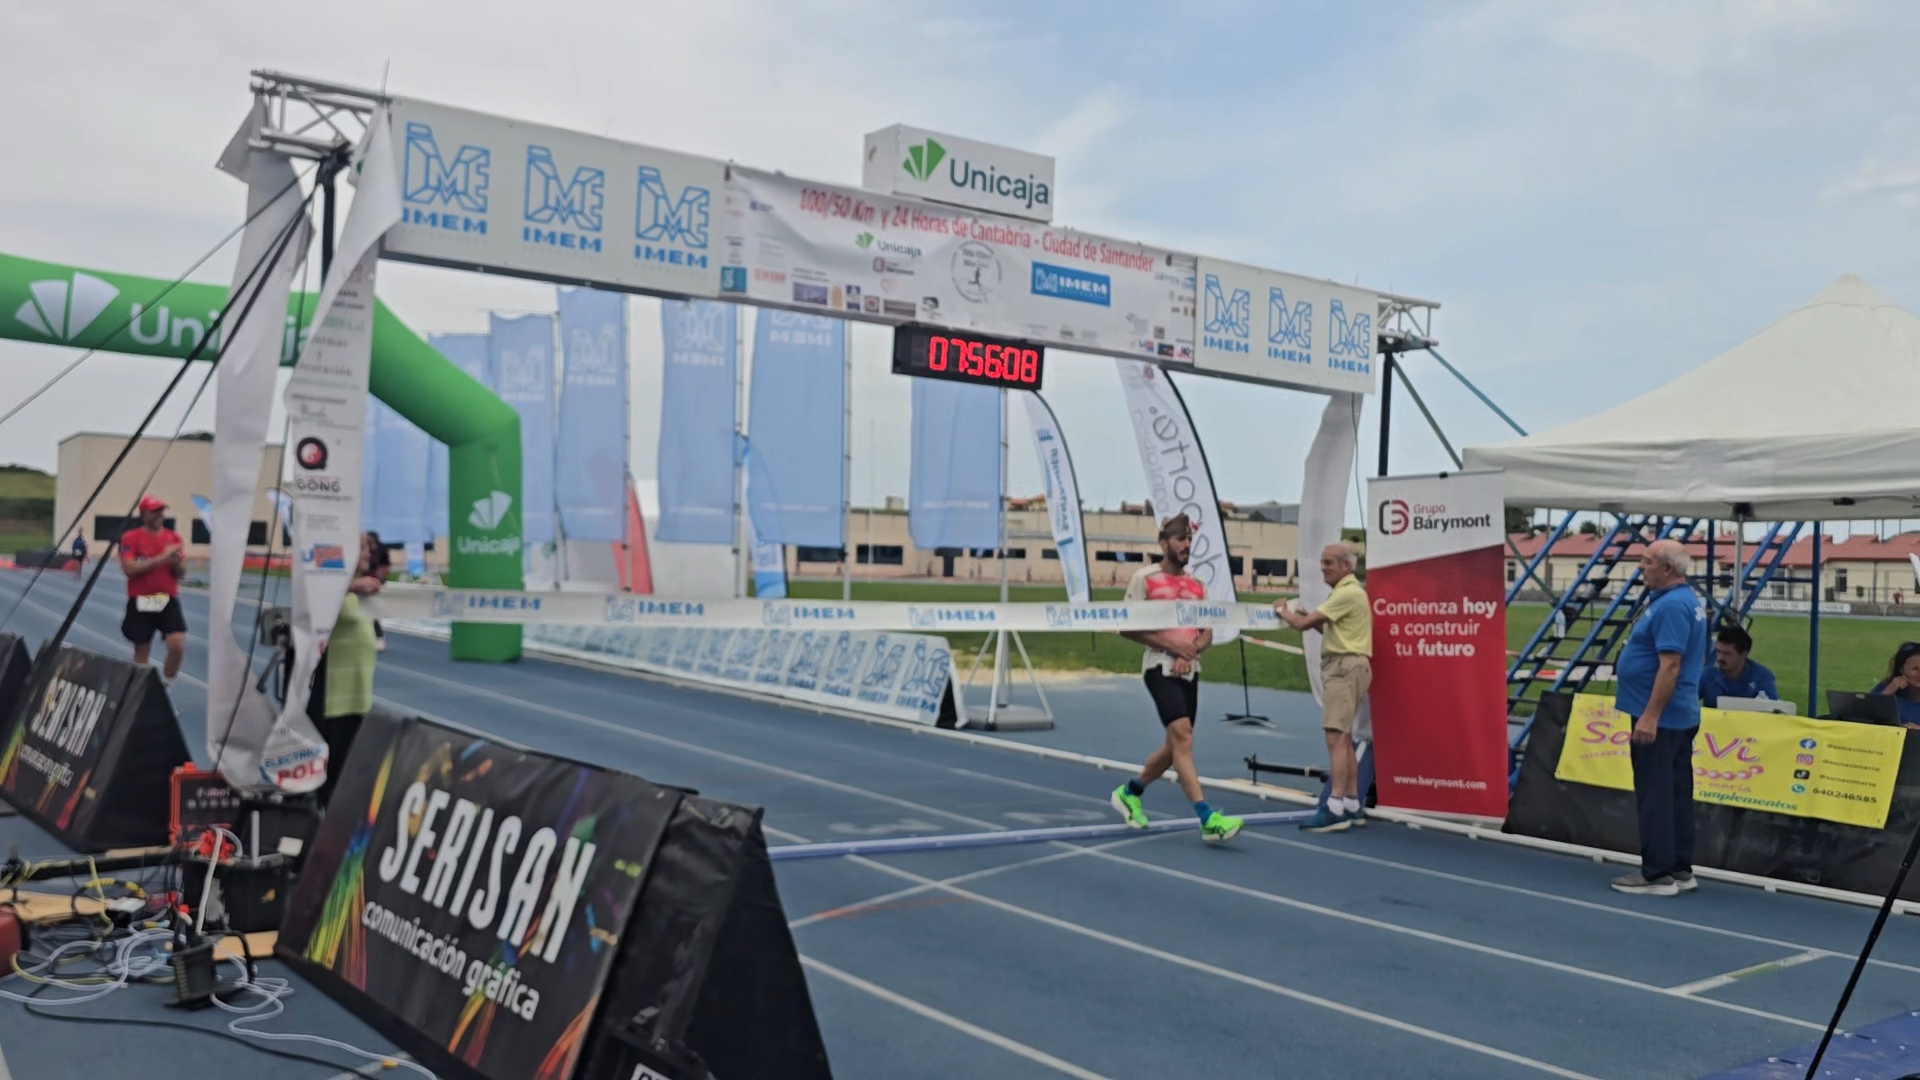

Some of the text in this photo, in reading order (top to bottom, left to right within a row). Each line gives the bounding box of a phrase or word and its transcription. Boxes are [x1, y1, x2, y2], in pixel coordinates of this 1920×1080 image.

[950, 158, 1049, 209] Unicaja
[402, 207, 488, 236] IMEM
[800, 188, 851, 218] 100/50
[852, 199, 875, 222] Km
[880, 208, 888, 230] y
[891, 205, 908, 228] 24
[911, 209, 949, 234] Horas
[952, 218, 967, 237] de
[970, 218, 1031, 249] Cantabria
[1042, 231, 1081, 259] Ciudad
[1083, 242, 1097, 261] de
[1100, 243, 1154, 272] Santander
[523, 227, 603, 253] IMEM
[634, 245, 708, 269] IMEM
[877, 241, 923, 259] Unicaja
[1059, 275, 1108, 295] IMEM
[1203, 335, 1250, 354] IMEM
[1267, 346, 1312, 365] IMEM
[1328, 357, 1370, 374] IMEM
[297, 479, 341, 492] GONG
[1413, 503, 1446, 515] Grupo
[1413, 514, 1491, 532] Bárymont
[468, 595, 543, 611] IMEM
[639, 601, 705, 616] IMEM
[1373, 597, 1498, 619] Comienza hoy
[793, 607, 856, 620] IMEM
[937, 608, 996, 621] IMEM
[1073, 607, 1129, 621] IMEM
[1389, 618, 1481, 636] a construir
[1395, 638, 1476, 657] tu futuro
[1580, 720, 1632, 745] So
[1393, 775, 1488, 791] www.barymont.com
[378, 781, 597, 965] SERISAN
[361, 900, 541, 1022] comunicación gráfica
